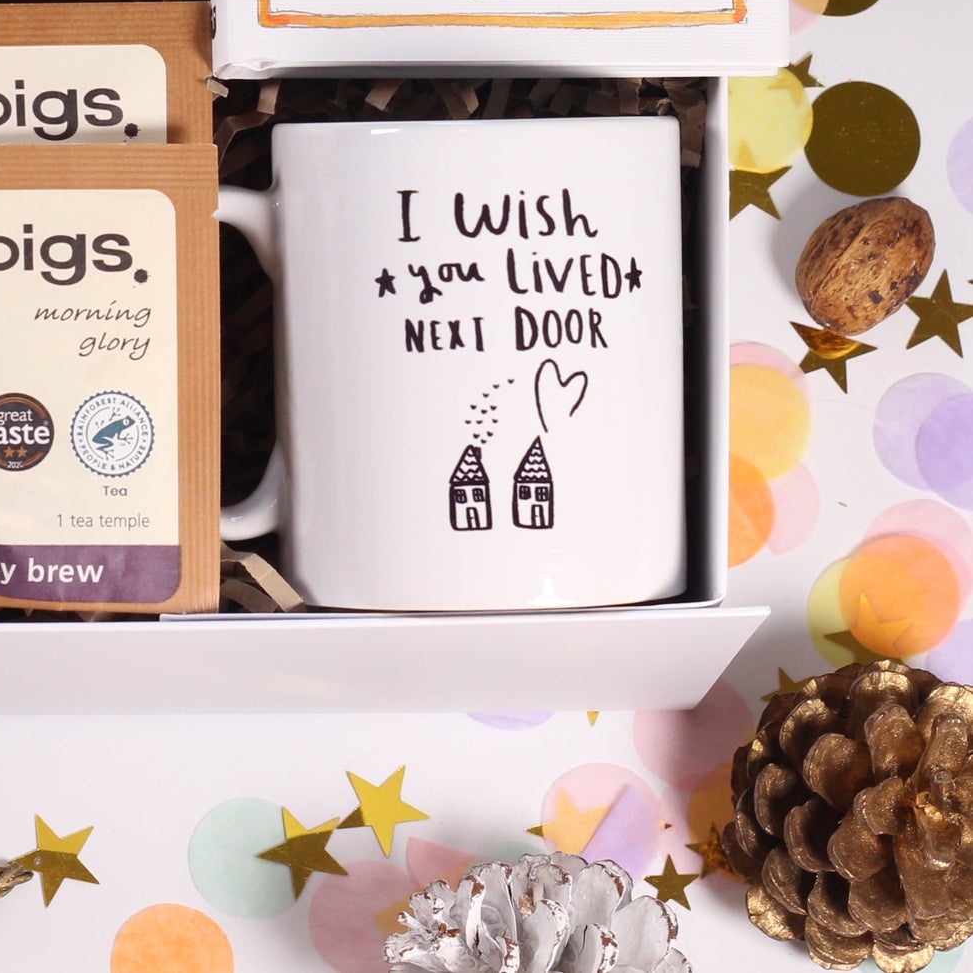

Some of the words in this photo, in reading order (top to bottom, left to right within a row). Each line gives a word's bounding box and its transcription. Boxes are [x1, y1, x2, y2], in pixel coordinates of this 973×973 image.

[396, 190, 421, 242] I
[408, 261, 485, 304] you
[34, 300, 151, 328] morning
[405, 316, 485, 352] NEXT
[514, 306, 608, 351] DOOR
[78, 332, 151, 360] glory
[102, 485, 128, 496] Tea
[56, 514, 64, 527] 1
[69, 514, 95, 528] tea
[98, 513, 150, 530] temple
[27, 559, 104, 584] brew
